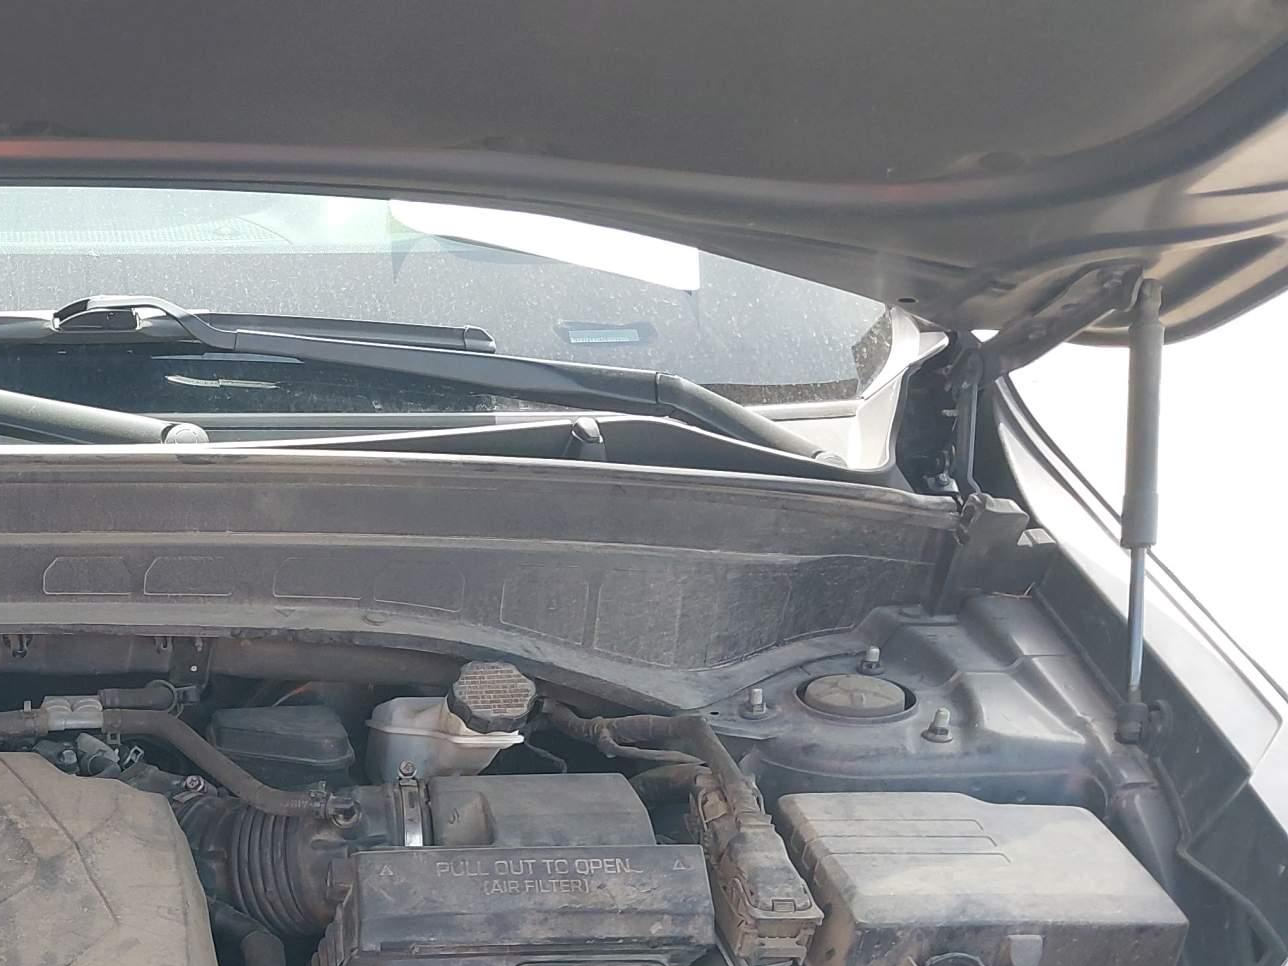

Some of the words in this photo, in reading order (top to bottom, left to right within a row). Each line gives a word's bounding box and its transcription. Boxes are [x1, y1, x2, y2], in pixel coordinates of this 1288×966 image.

[436, 861, 489, 877] PULL
[494, 859, 536, 876] OUT
[575, 858, 631, 875] OPEN
